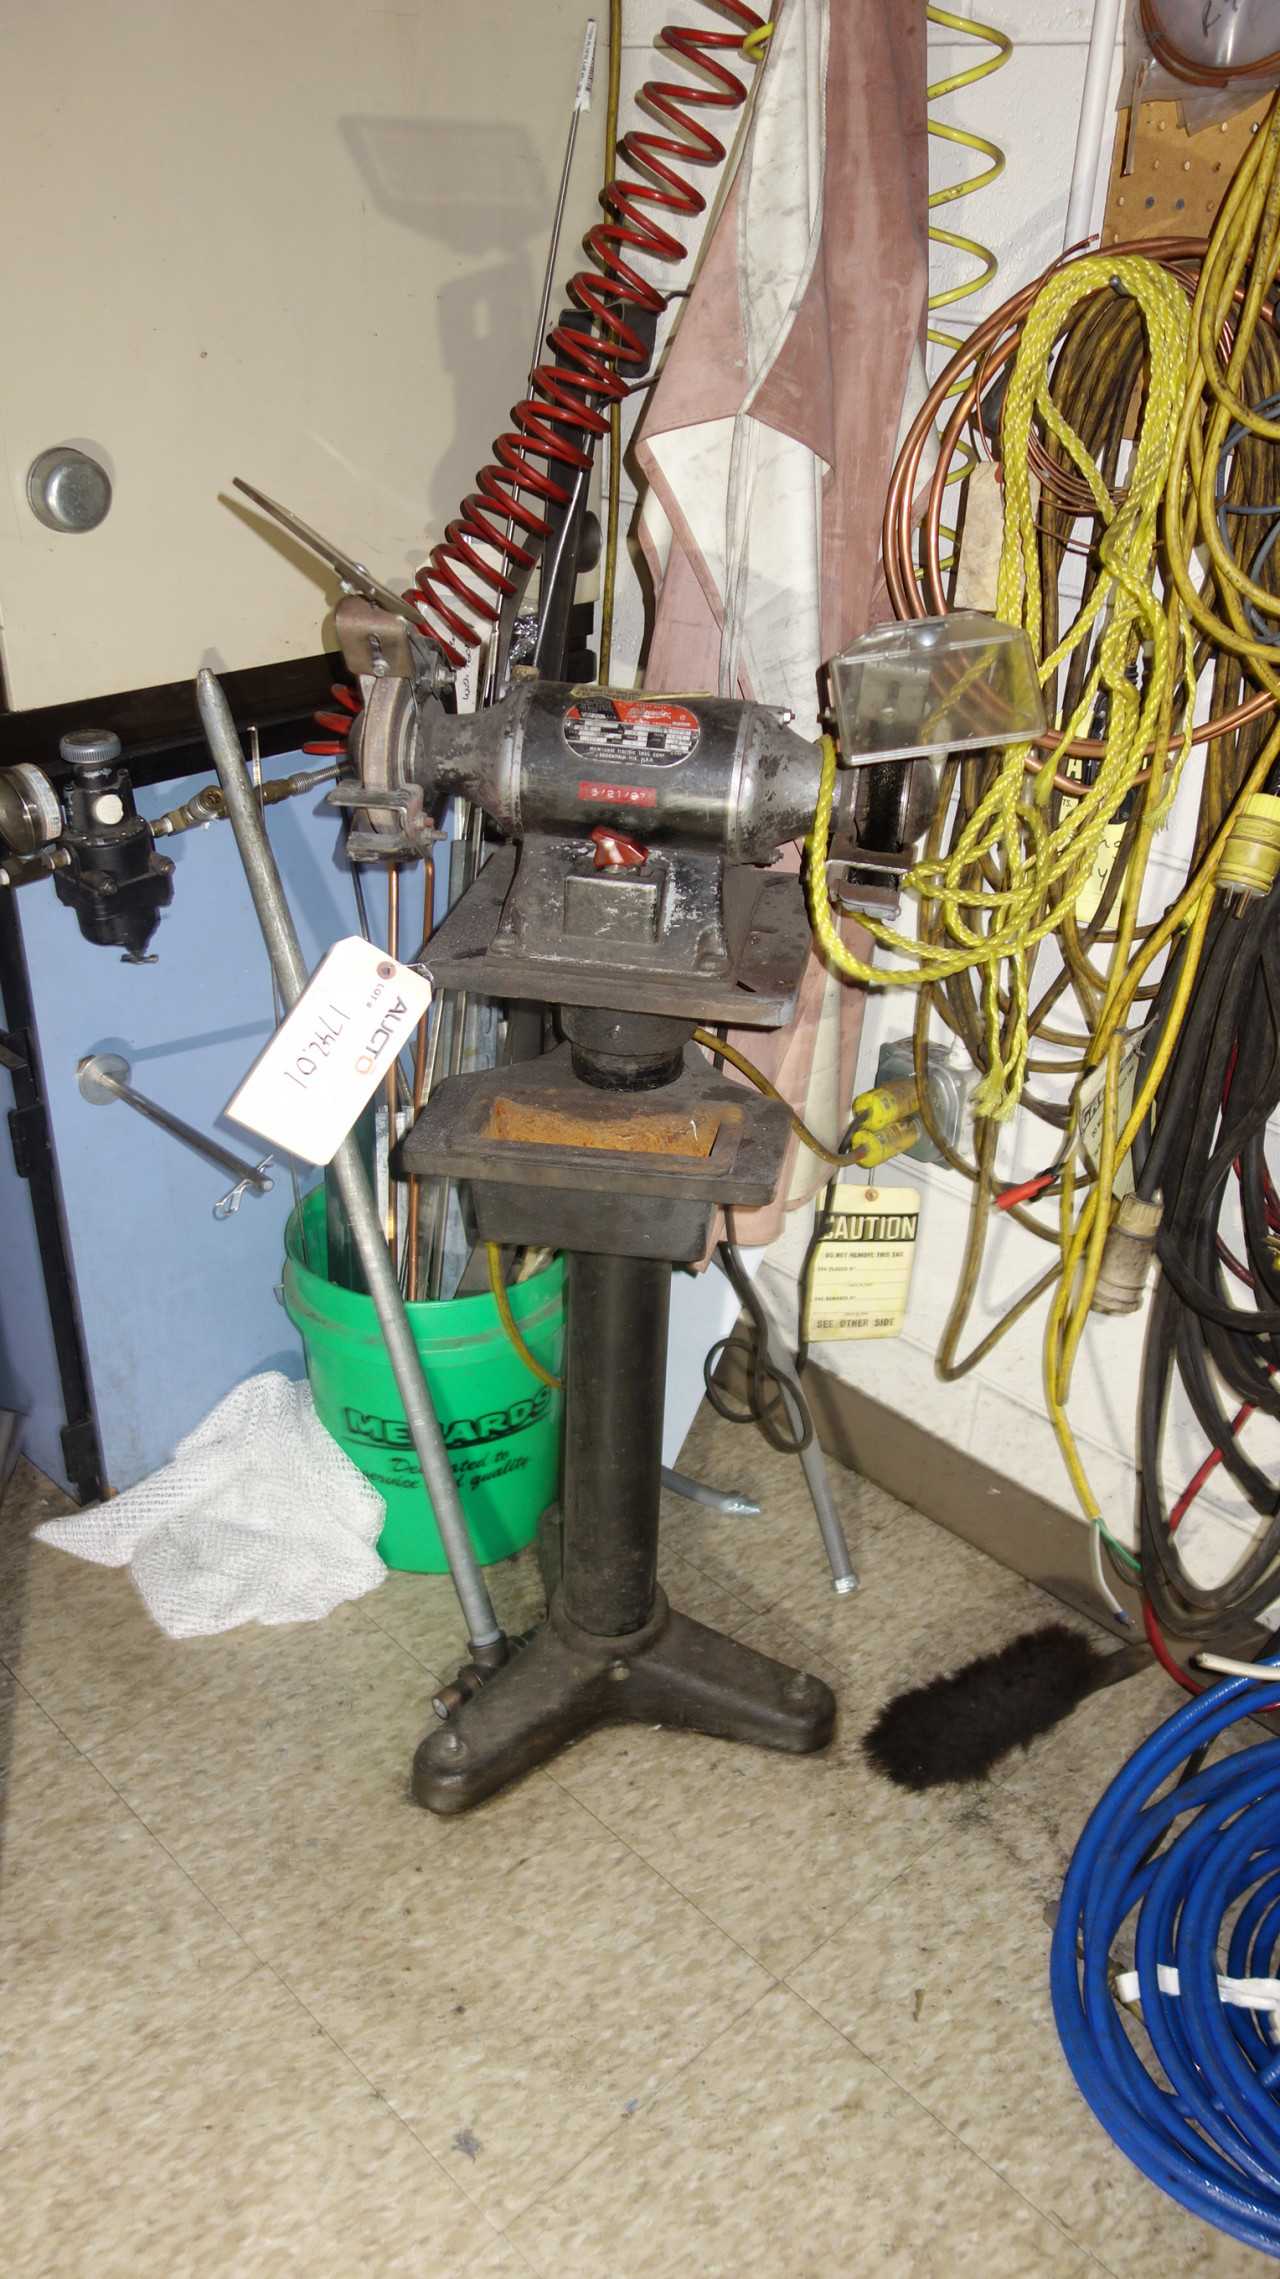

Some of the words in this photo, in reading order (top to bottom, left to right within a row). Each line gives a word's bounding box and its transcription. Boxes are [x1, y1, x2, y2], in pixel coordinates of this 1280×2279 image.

[354, 996, 408, 1074] AUCTO
[816, 1320, 834, 1329] SEE
[840, 1319, 868, 1328] OTHER
[874, 1318, 895, 1327] SIDE
[344, 1384, 551, 1445] MEARDS
